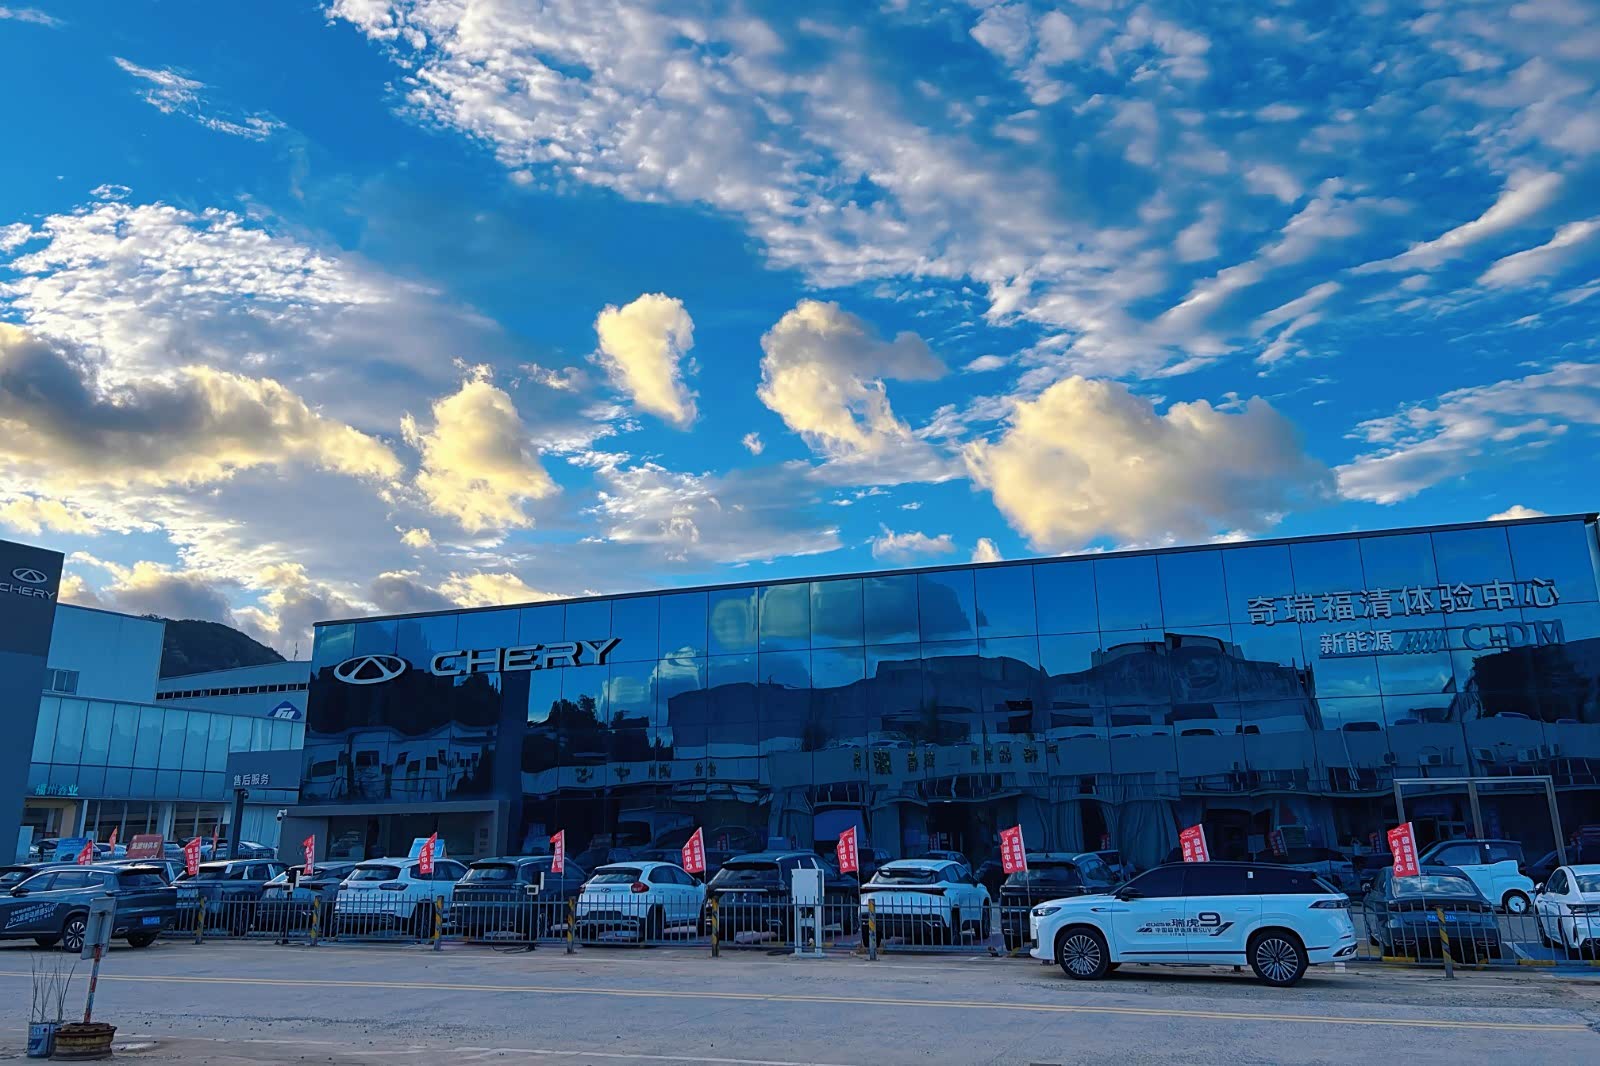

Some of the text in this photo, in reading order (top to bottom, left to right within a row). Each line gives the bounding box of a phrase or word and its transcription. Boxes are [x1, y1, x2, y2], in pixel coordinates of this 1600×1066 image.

[0, 582, 56, 600] CHERY
[1247, 577, 1561, 626] 奇瑞福清体验中心
[1319, 630, 1394, 654] 新能源
[430, 637, 623, 677] CHERY
[233, 773, 269, 786] 售后服务
